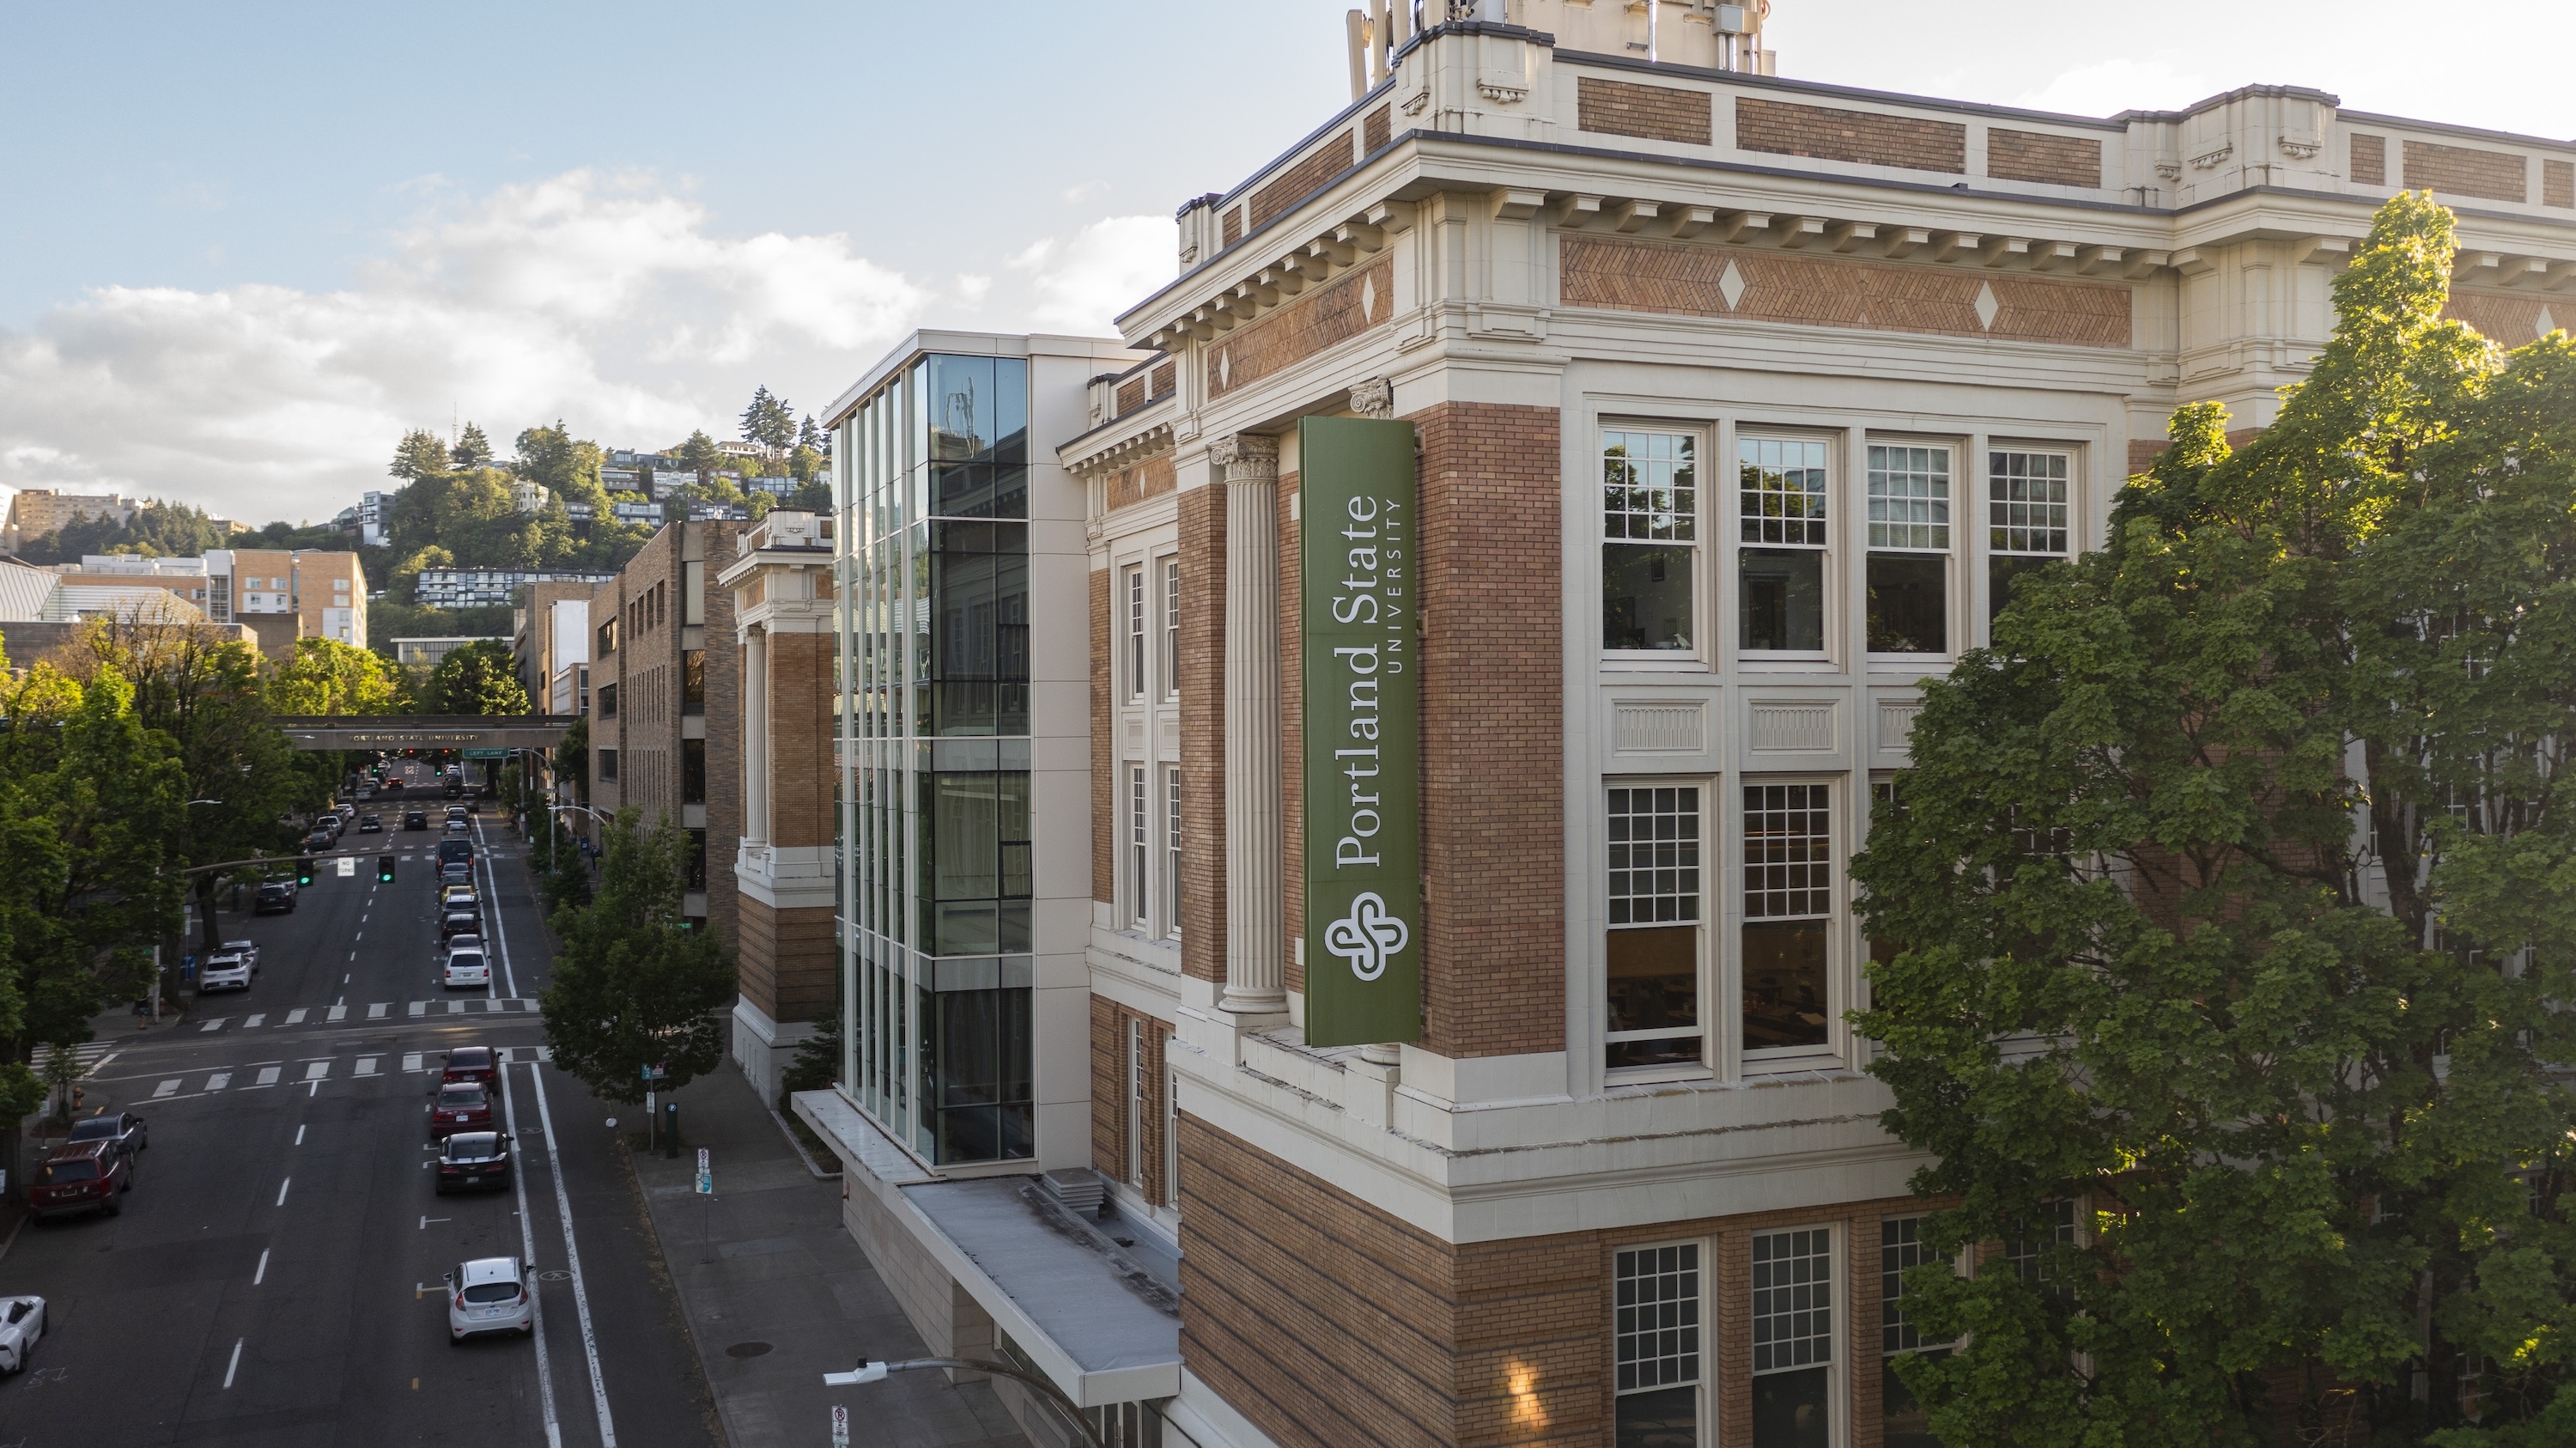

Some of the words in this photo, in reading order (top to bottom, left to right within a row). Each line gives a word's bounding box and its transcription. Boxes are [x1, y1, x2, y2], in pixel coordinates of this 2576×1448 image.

[1332, 496, 1378, 624] State
[1386, 498, 1403, 674] UNIVERSITY
[1334, 643, 1380, 869] Portland
